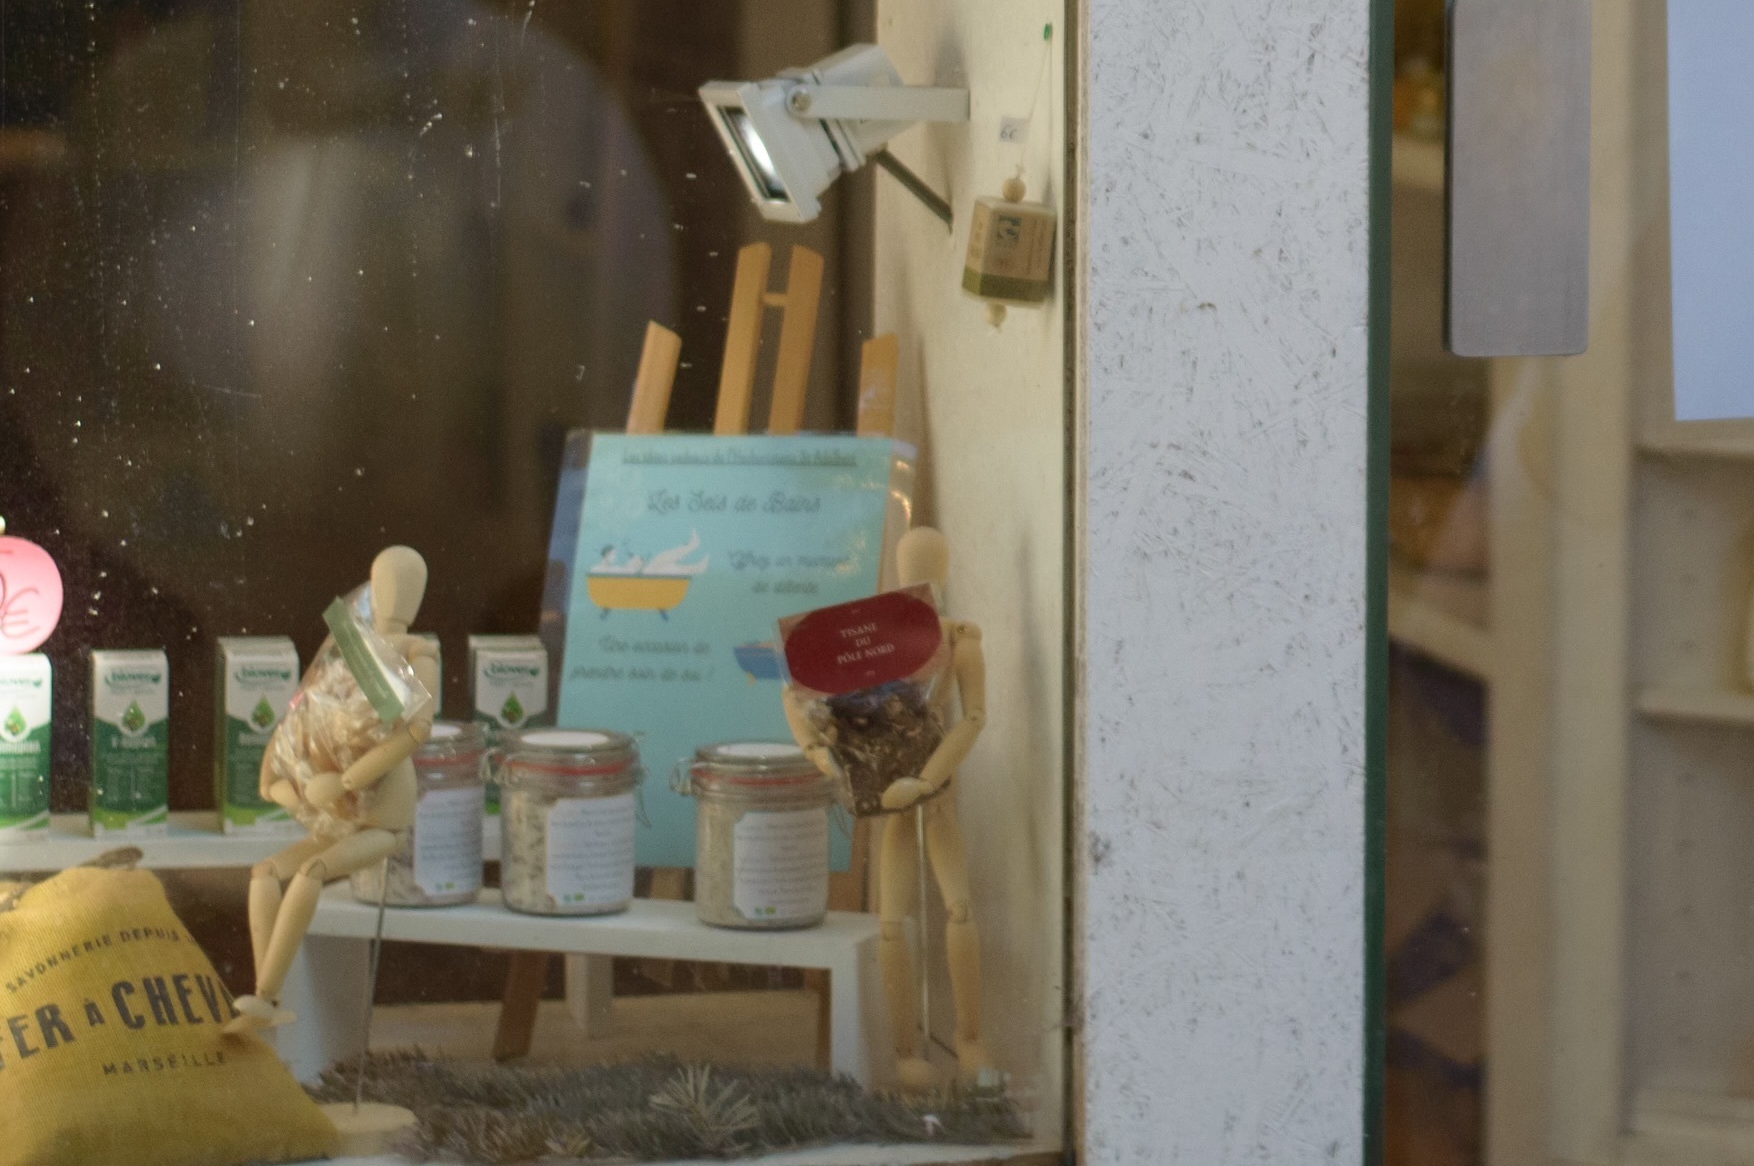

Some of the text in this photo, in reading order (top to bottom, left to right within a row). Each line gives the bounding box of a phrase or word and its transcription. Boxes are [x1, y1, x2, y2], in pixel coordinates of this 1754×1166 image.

[840, 622, 879, 638] TISANE
[855, 637, 871, 648] DU
[864, 642, 895, 660] NORD
[6, 926, 181, 994] SAVONNERIE DEPUIS
[0, 1003, 76, 1070] ER
[83, 997, 105, 1027] À
[101, 1051, 227, 1075] MARSEILLE
